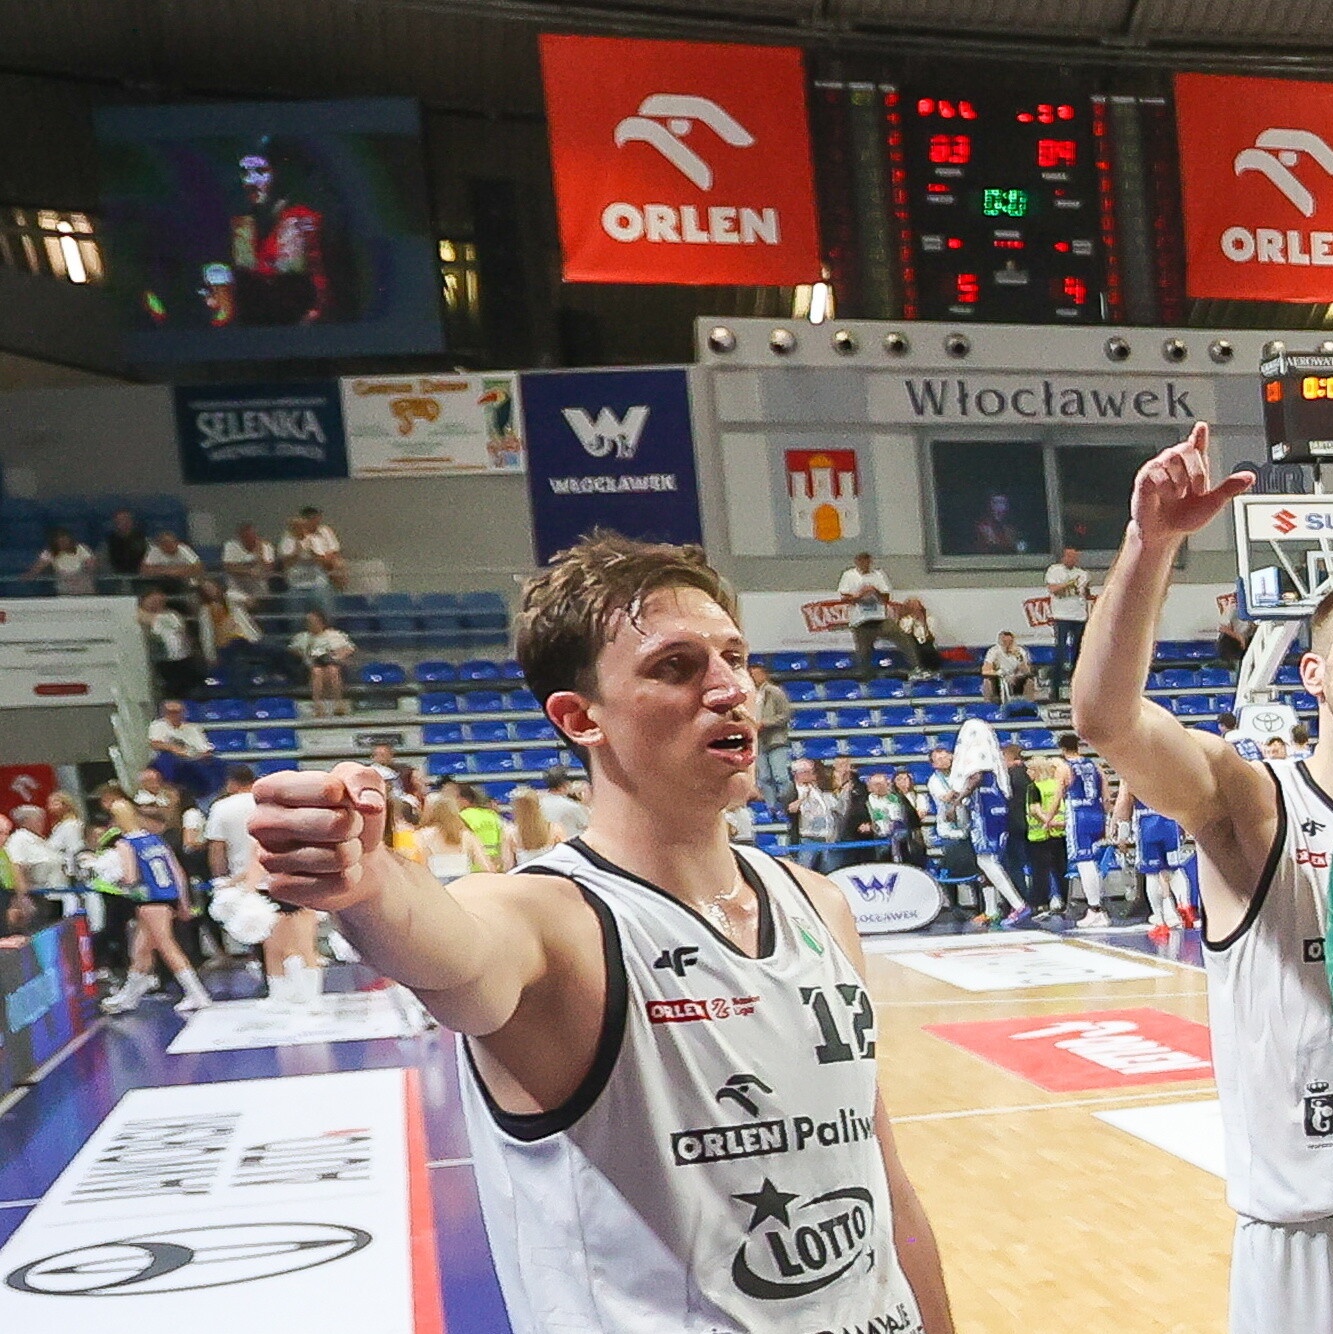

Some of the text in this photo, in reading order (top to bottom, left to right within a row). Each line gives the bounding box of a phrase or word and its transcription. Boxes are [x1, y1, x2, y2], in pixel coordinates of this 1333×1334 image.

[602, 202, 781, 246] ORLEN
[904, 376, 1196, 421] Włocławek
[653, 946, 699, 977] 4F
[651, 1002, 705, 1019] ORLEN
[799, 983, 876, 1065] 12
[676, 1108, 874, 1161] ORLEN Paliw
[765, 1205, 867, 1278] LOTTO
